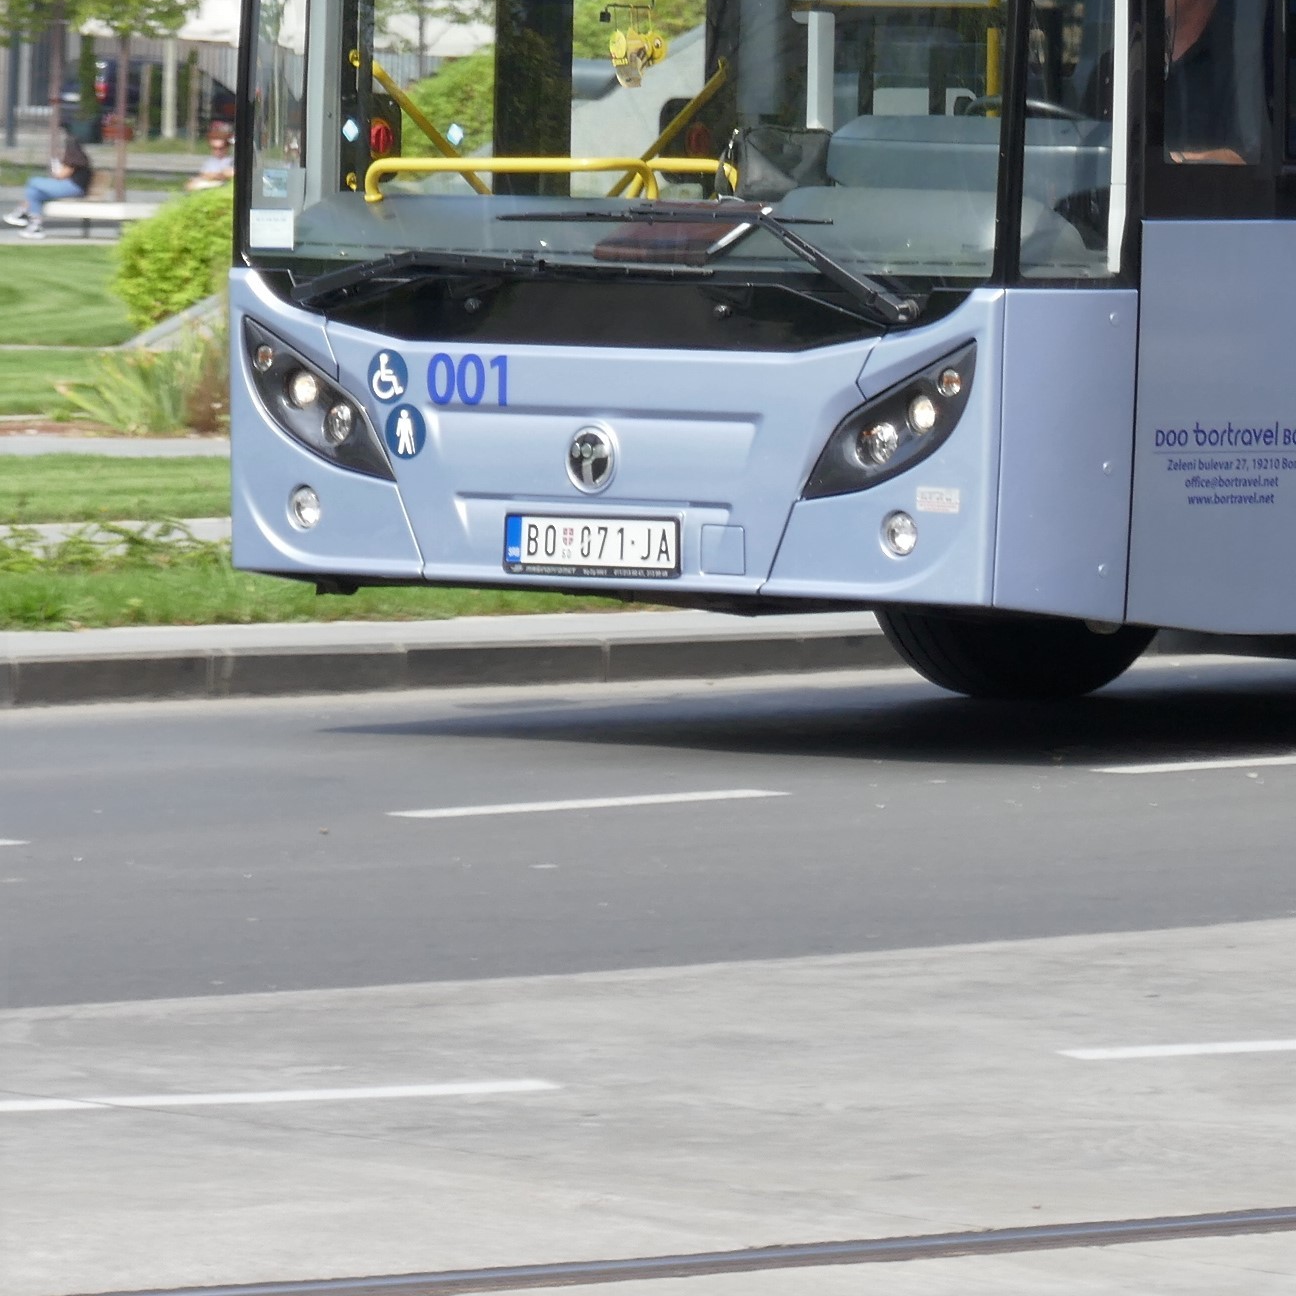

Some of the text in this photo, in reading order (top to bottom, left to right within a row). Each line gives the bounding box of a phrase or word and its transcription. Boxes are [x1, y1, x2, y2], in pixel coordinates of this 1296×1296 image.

[427, 353, 507, 406] 001
[1155, 429, 1188, 447] DOO
[1193, 421, 1279, 446] bortravel
[1167, 458, 1196, 471] Zeleni
[1199, 458, 1233, 471] bulevar
[1253, 458, 1280, 470] 19210
[1185, 475, 1279, 489] office@bortravel.net
[1188, 493, 1275, 505] www.bortravel.net
[527, 524, 556, 557] BO
